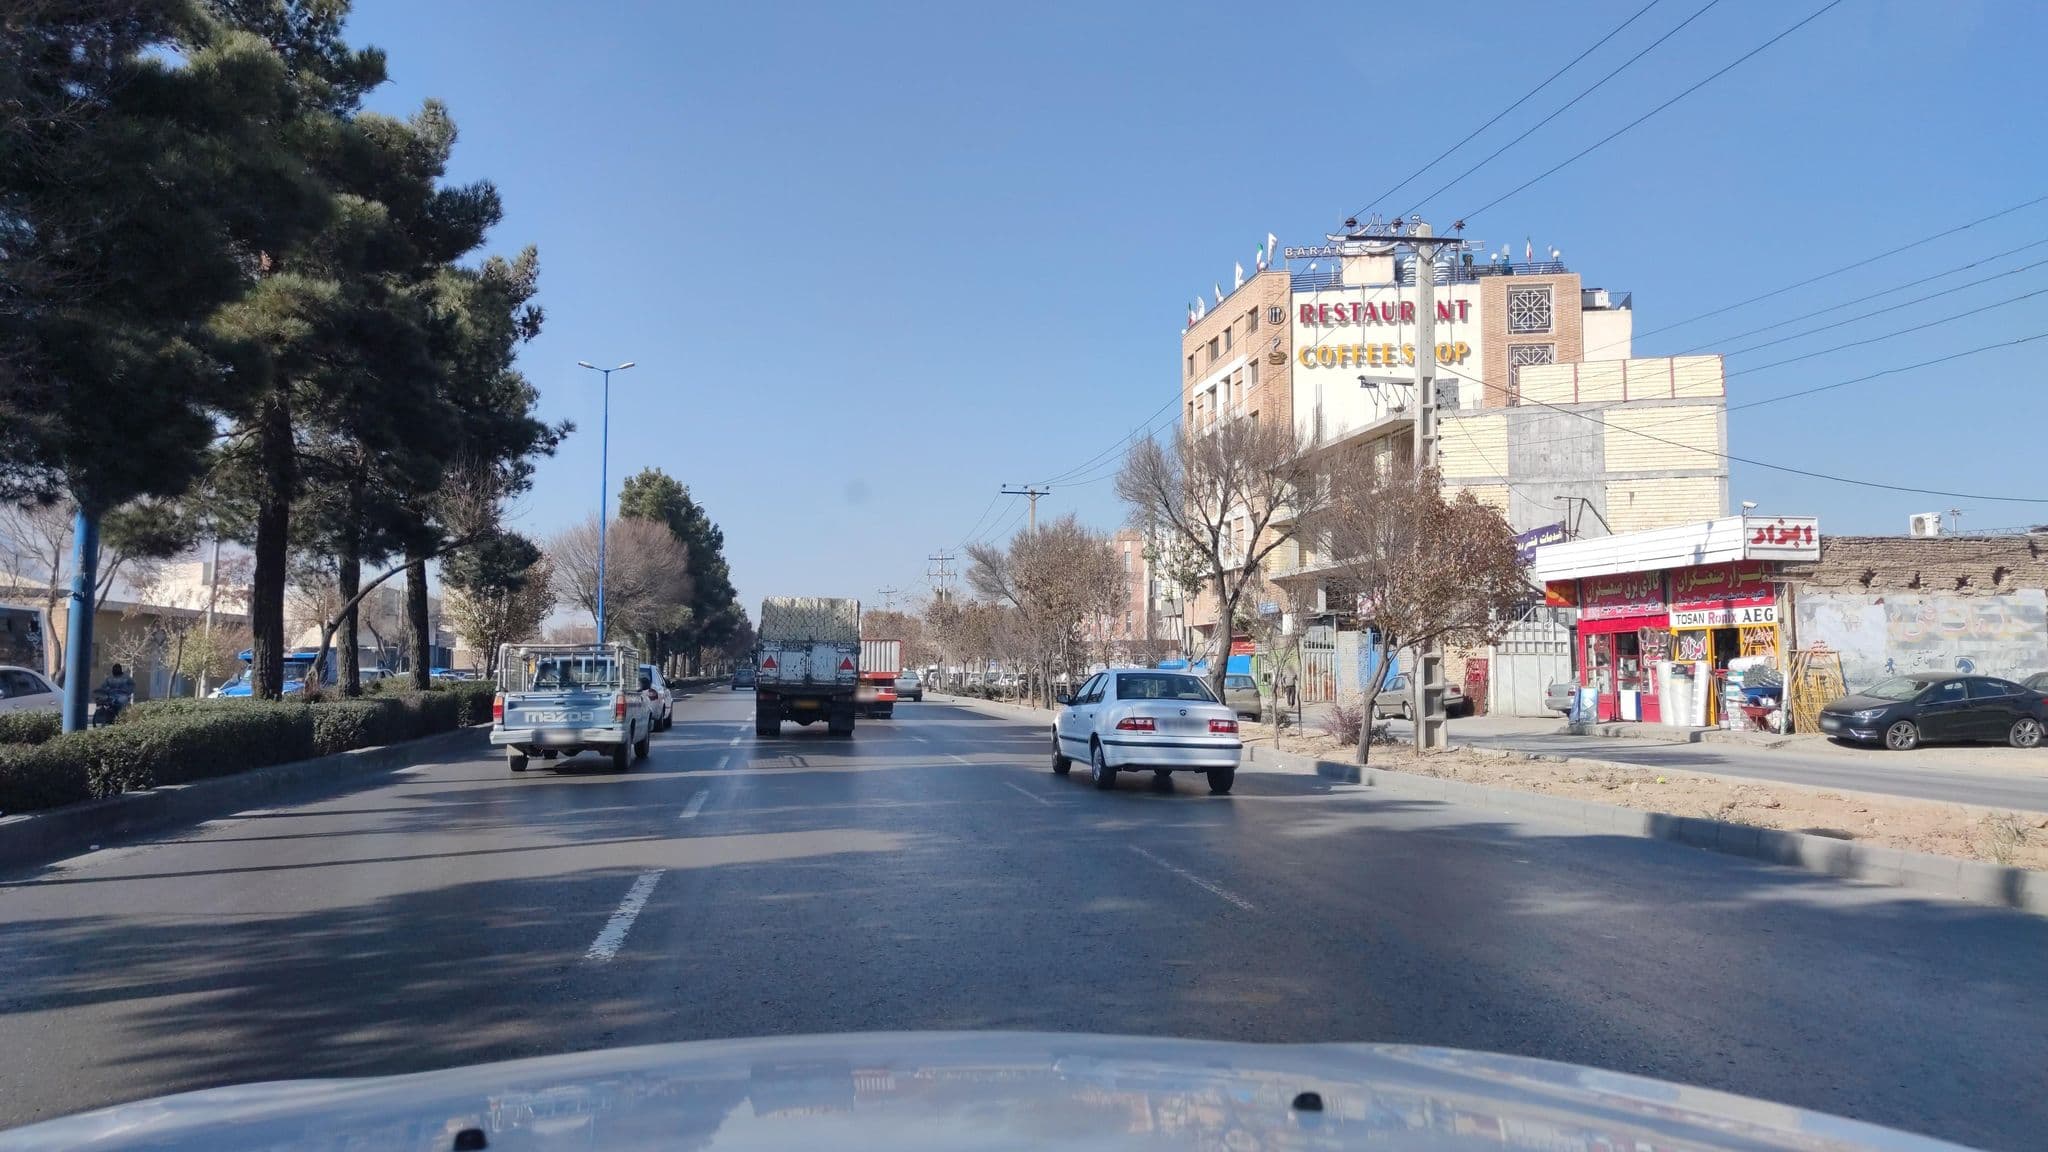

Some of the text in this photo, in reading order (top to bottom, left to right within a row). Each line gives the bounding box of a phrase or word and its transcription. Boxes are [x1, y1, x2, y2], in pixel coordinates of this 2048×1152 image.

[1285, 244, 1345, 257] BARAN
[1299, 299, 1470, 325] RESTAURNT
[1402, 342, 1471, 365] SOP
[1751, 519, 1813, 549] ابزار
[1676, 608, 1773, 625] TOSAN Ronix AEG
